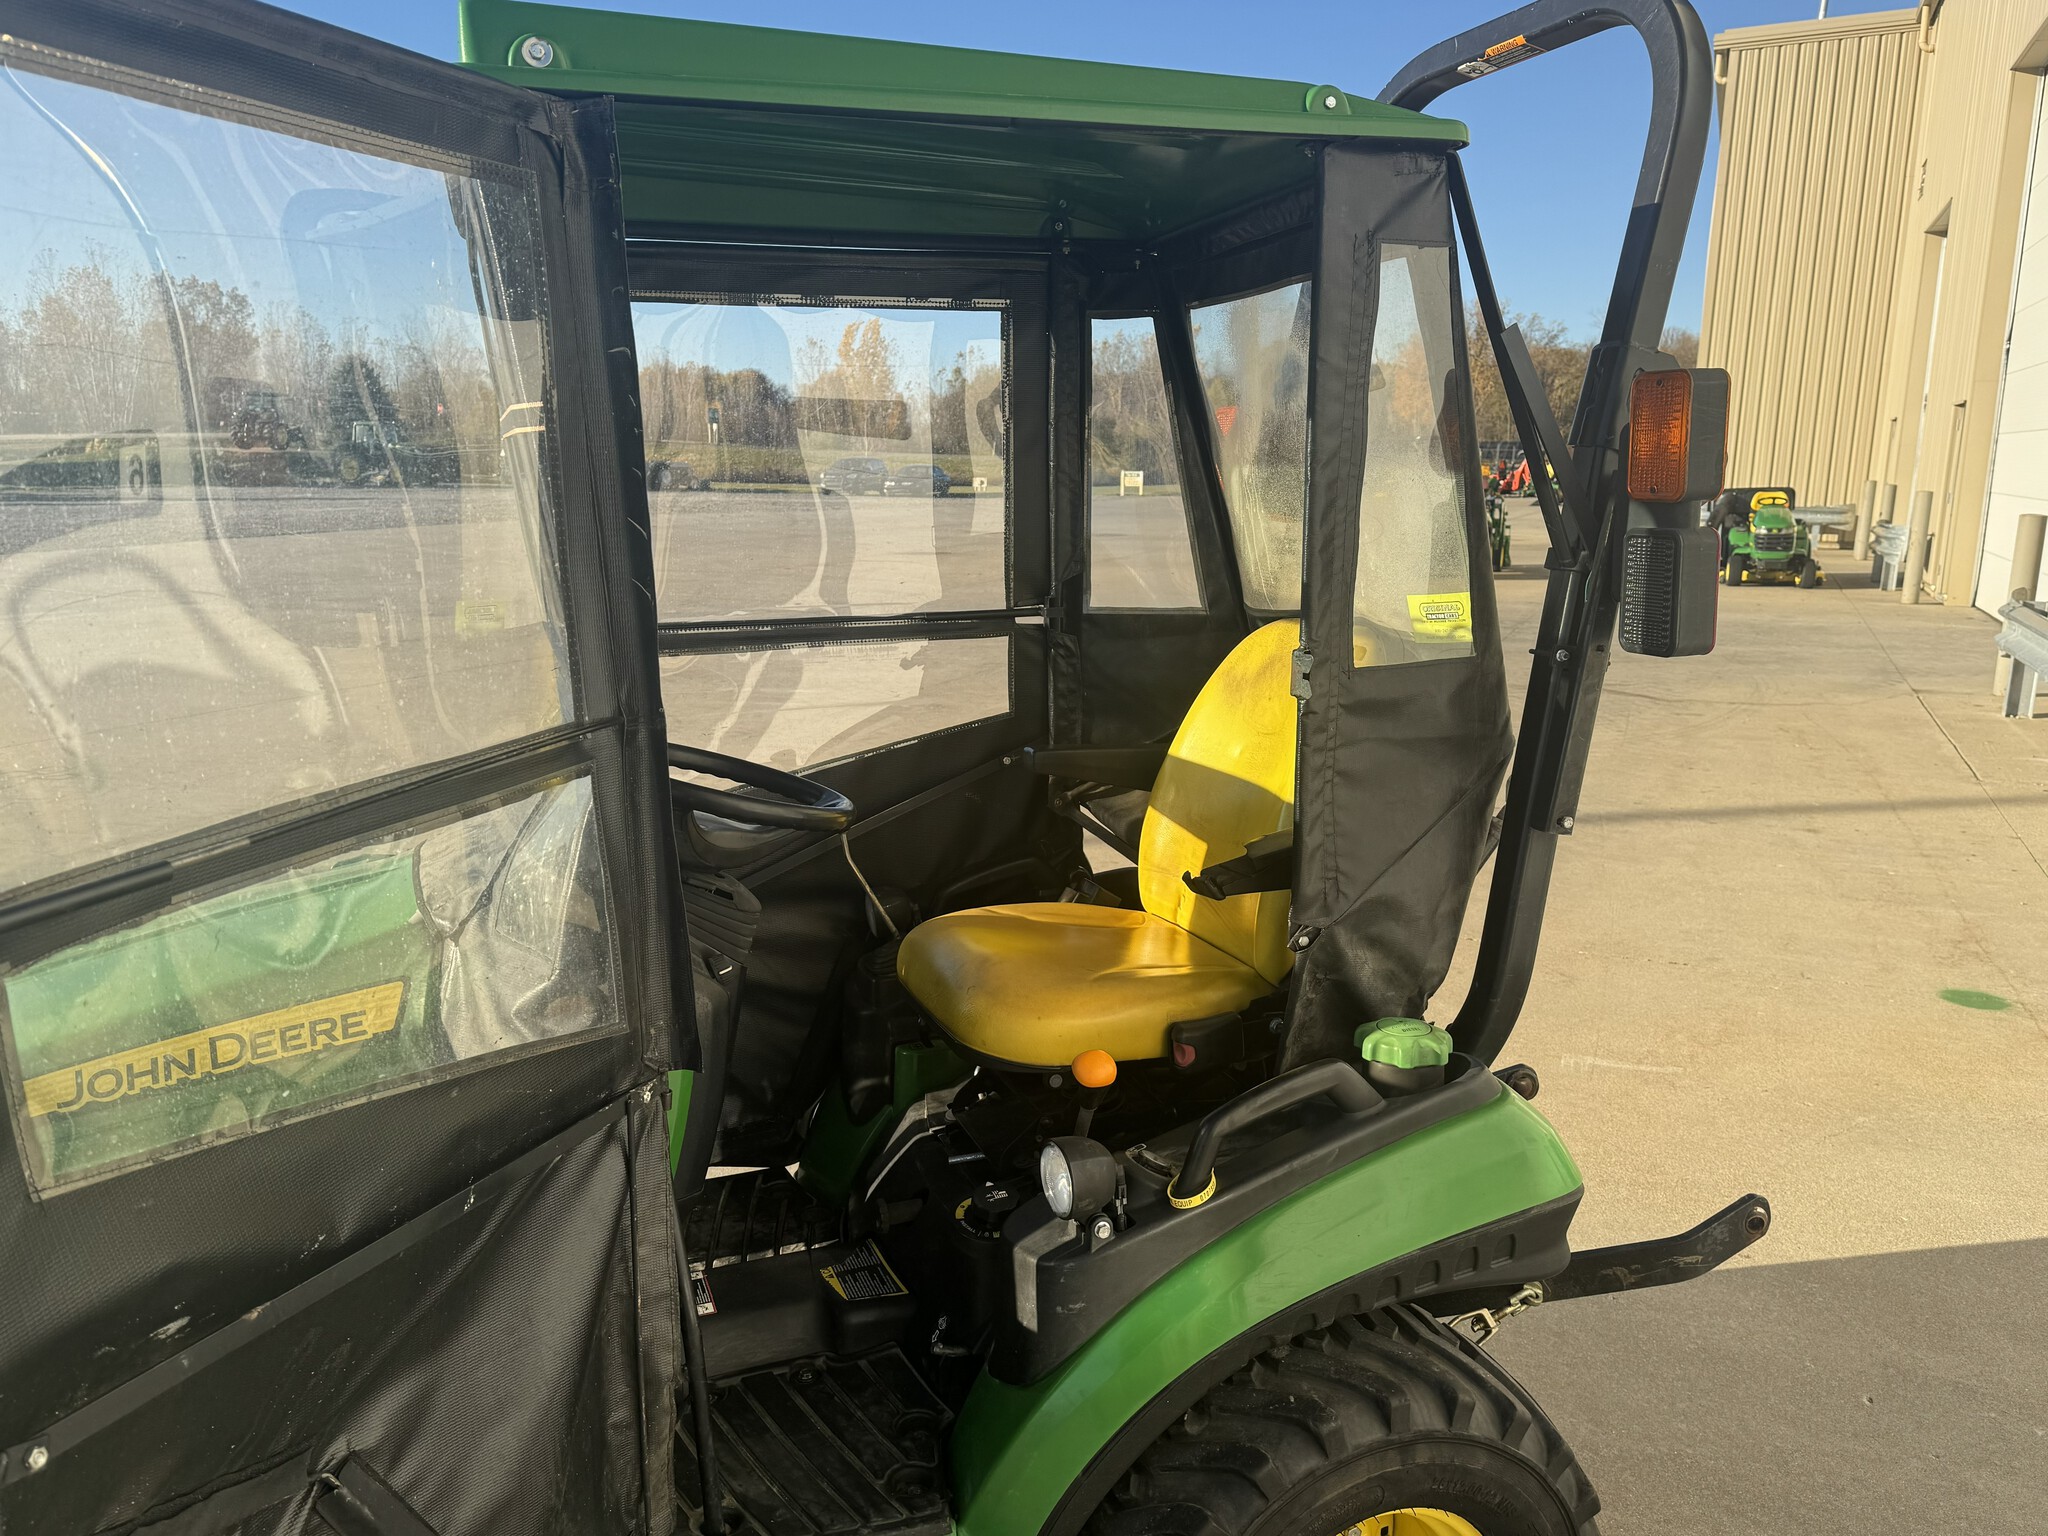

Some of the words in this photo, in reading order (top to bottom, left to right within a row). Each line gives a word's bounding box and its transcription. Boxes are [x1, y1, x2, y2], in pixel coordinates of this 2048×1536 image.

[1491, 39, 1519, 55] WARNING
[56, 1048, 197, 1109] JOHN
[208, 1010, 369, 1070] DEERE
